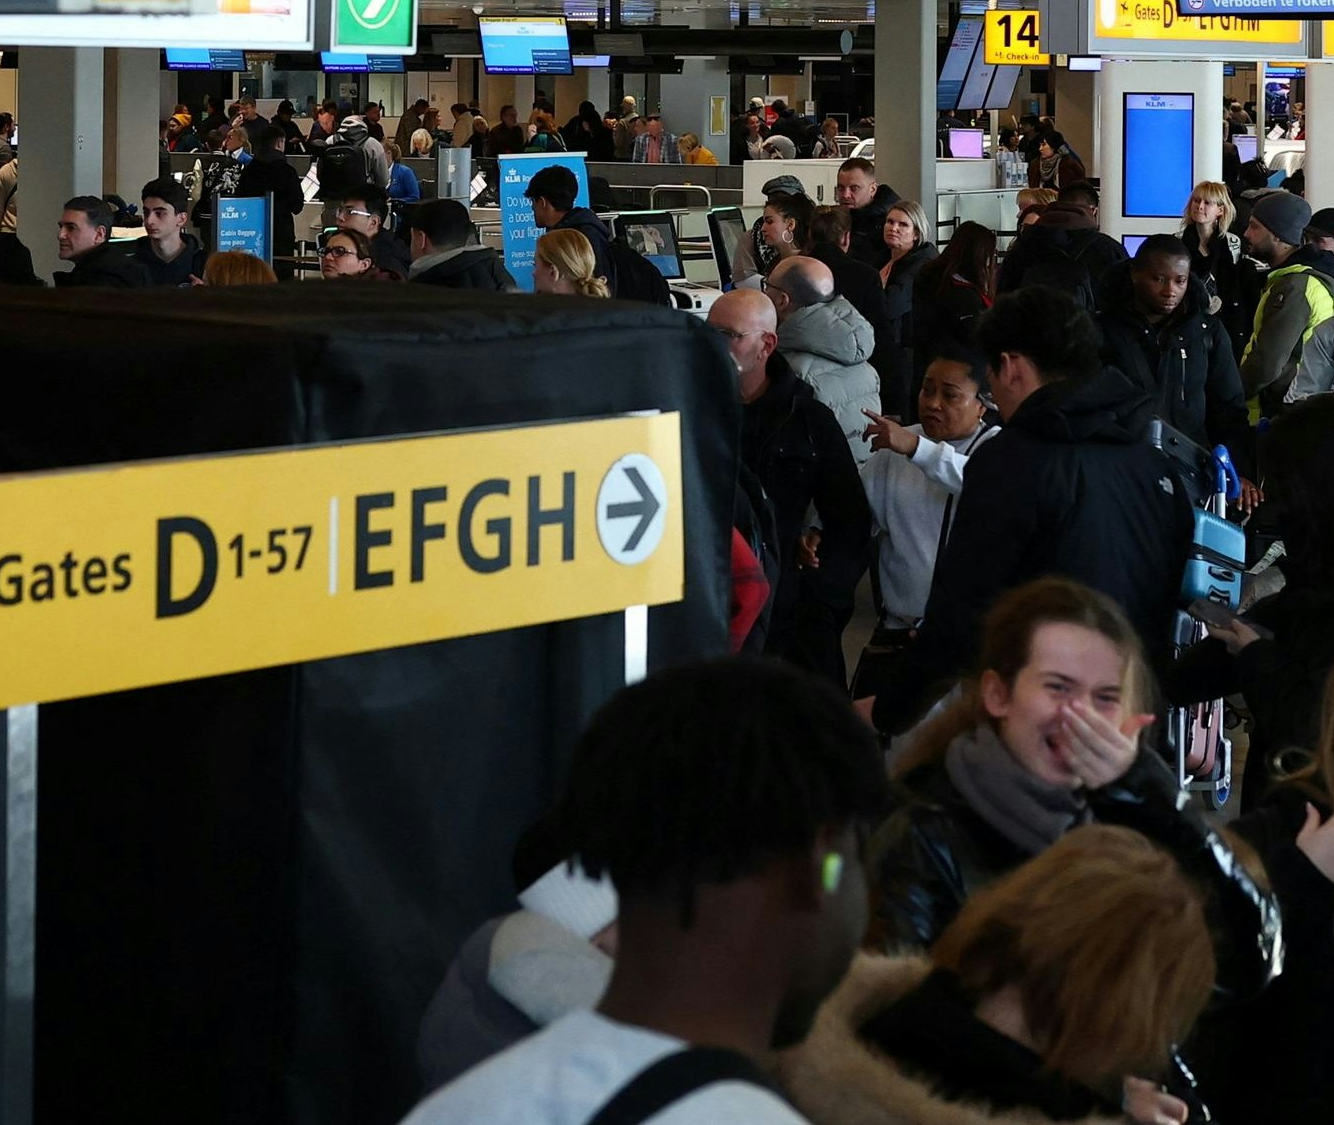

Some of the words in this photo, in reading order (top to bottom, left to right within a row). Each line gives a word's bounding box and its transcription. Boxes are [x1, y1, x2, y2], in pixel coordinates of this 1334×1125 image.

[1135, 3, 1160, 21] Gates
[997, 15, 1039, 47] 14
[505, 175, 521, 183] KLM
[507, 197, 518, 207] Do
[509, 230, 525, 241] your
[354, 471, 576, 592] EFGH
